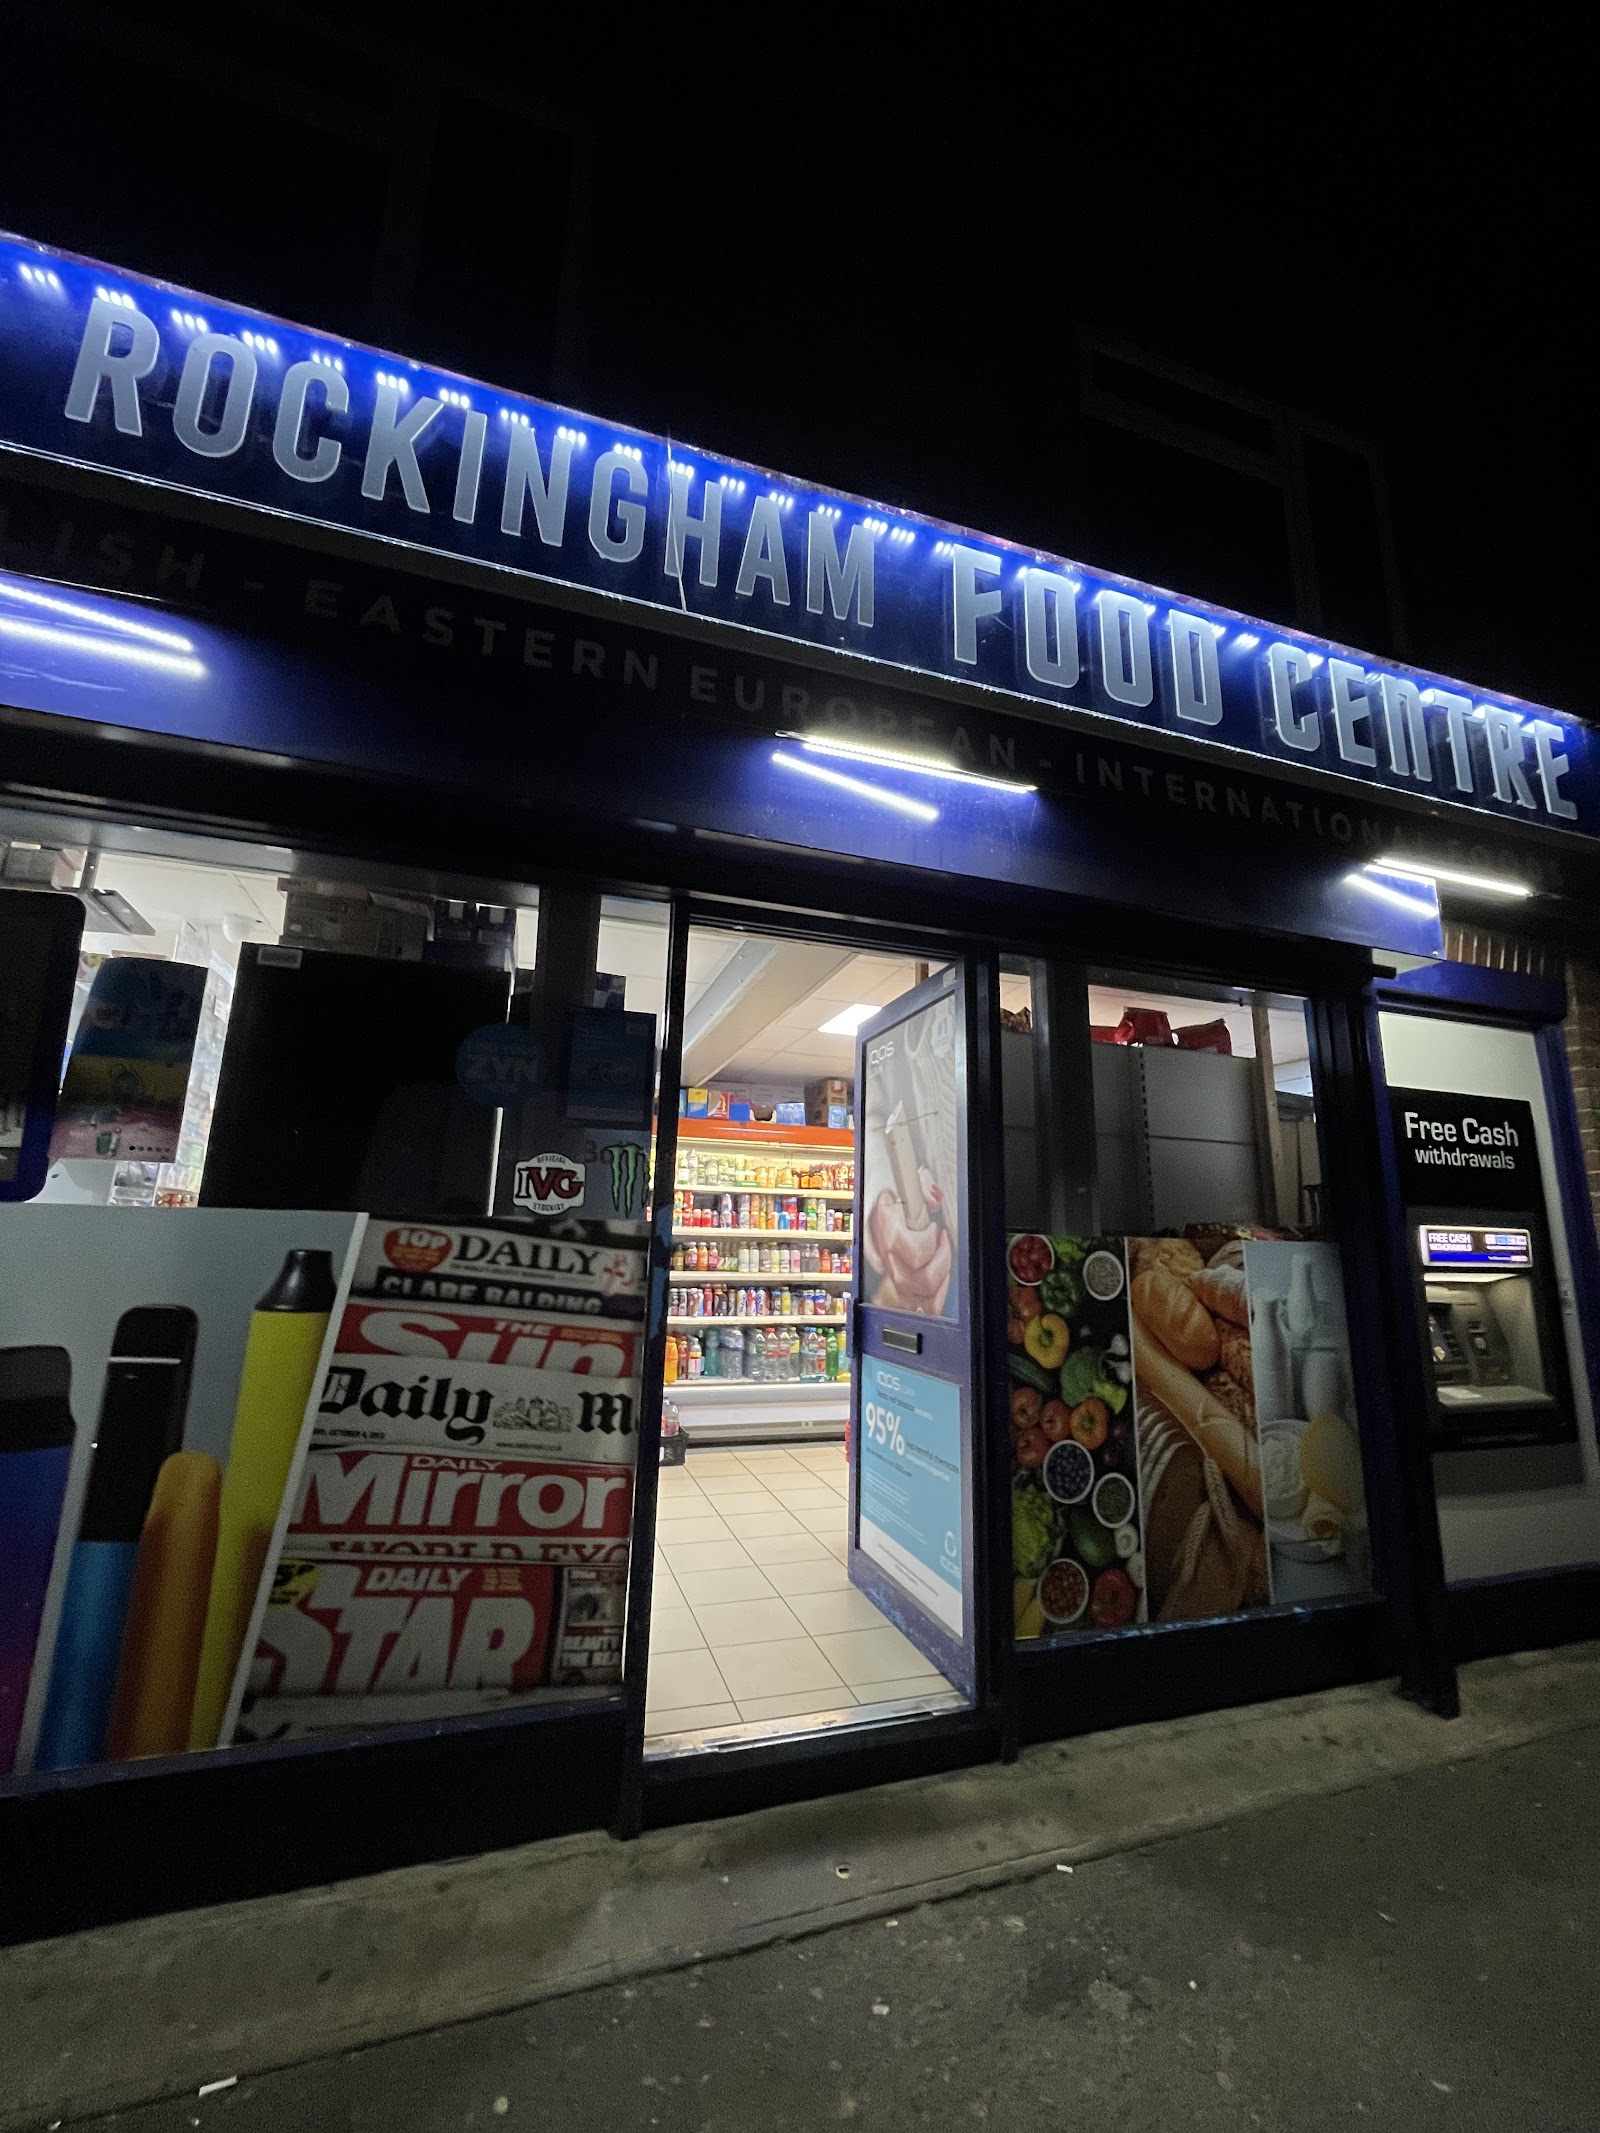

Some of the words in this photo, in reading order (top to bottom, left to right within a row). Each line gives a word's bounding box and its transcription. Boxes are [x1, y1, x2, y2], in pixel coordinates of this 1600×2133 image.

[64, 296, 876, 628] ROCKINGHAM
[950, 543, 1224, 727] FOOD
[1268, 641, 1581, 820] CENTRE
[304, 577, 660, 692] EASTERN
[689, 664, 1017, 772] EUROPEAN
[464, 1053, 541, 1084] ZYN
[1404, 1111, 1457, 1142] Free
[1462, 1117, 1519, 1147] Cash
[1415, 1145, 1516, 1170] withdrawals
[516, 1166, 584, 1201] IVG
[454, 1235, 600, 1276] DAILY
[1428, 1232, 1448, 1243] FREE
[1449, 1233, 1471, 1244] CASH
[493, 1319, 556, 1337] THE
[317, 1366, 495, 1445] Daily
[865, 1401, 906, 1457] 95%
[411, 1456, 503, 1471] DAILY
[288, 1453, 628, 1531] Mirror
[364, 1567, 472, 1593] DAILY
[247, 1563, 537, 1696] STAR
